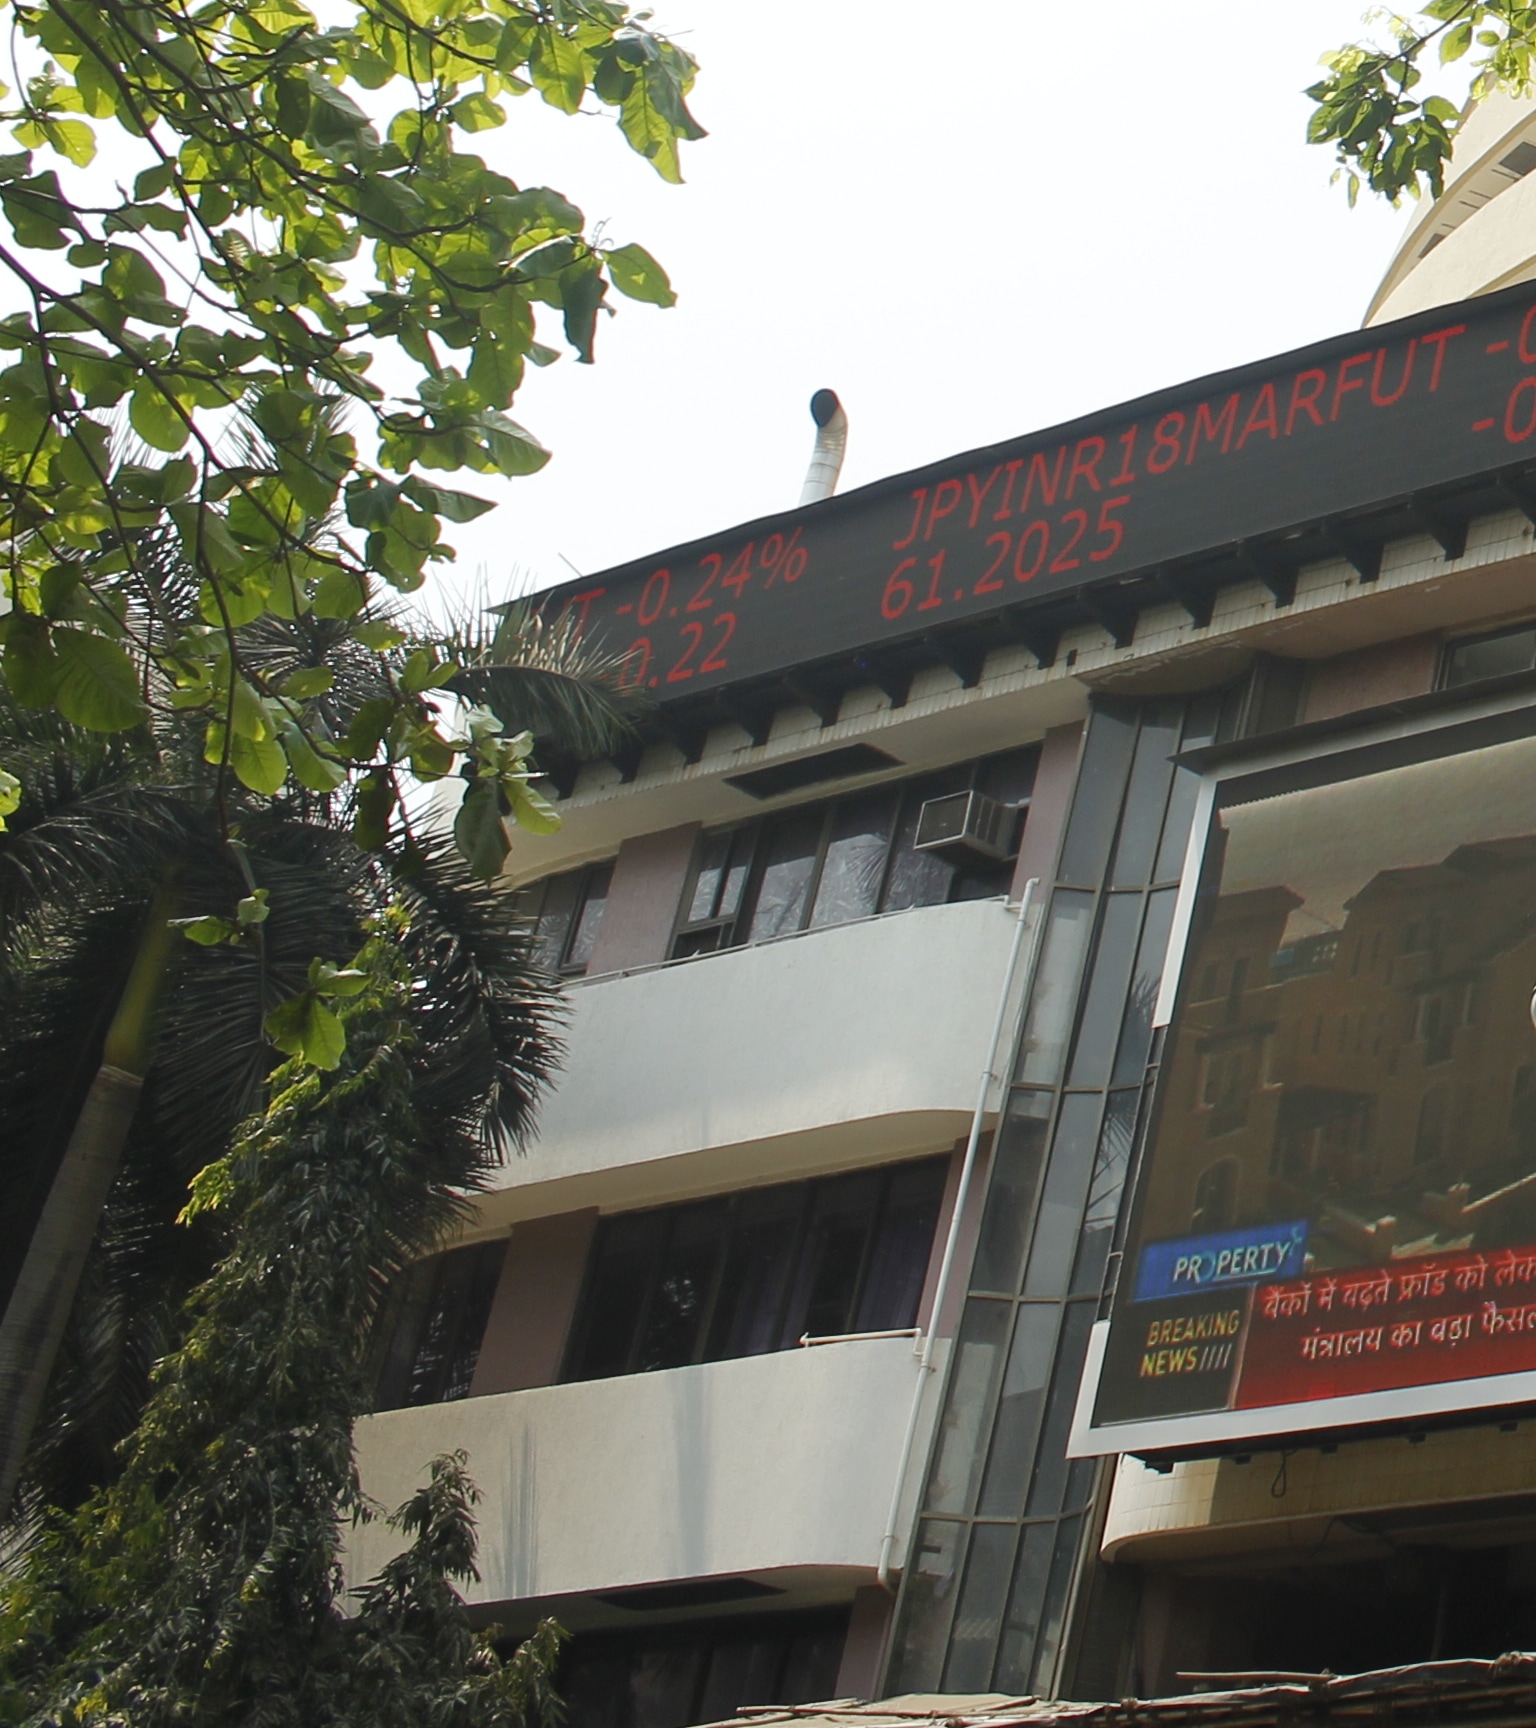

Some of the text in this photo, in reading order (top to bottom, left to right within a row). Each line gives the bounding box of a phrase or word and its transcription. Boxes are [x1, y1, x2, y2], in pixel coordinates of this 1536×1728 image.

[893, 324, 1467, 550] JPYINR18MARFUT
[616, 527, 809, 627] -0.24%
[880, 495, 1131, 621] 61.2025
[1172, 1240, 1291, 1284] PROPERTY
[1318, 1277, 1338, 1312] में
[1454, 1253, 1489, 1292] को
[1146, 1309, 1241, 1348] BREAKING
[1390, 1320, 1424, 1348] का
